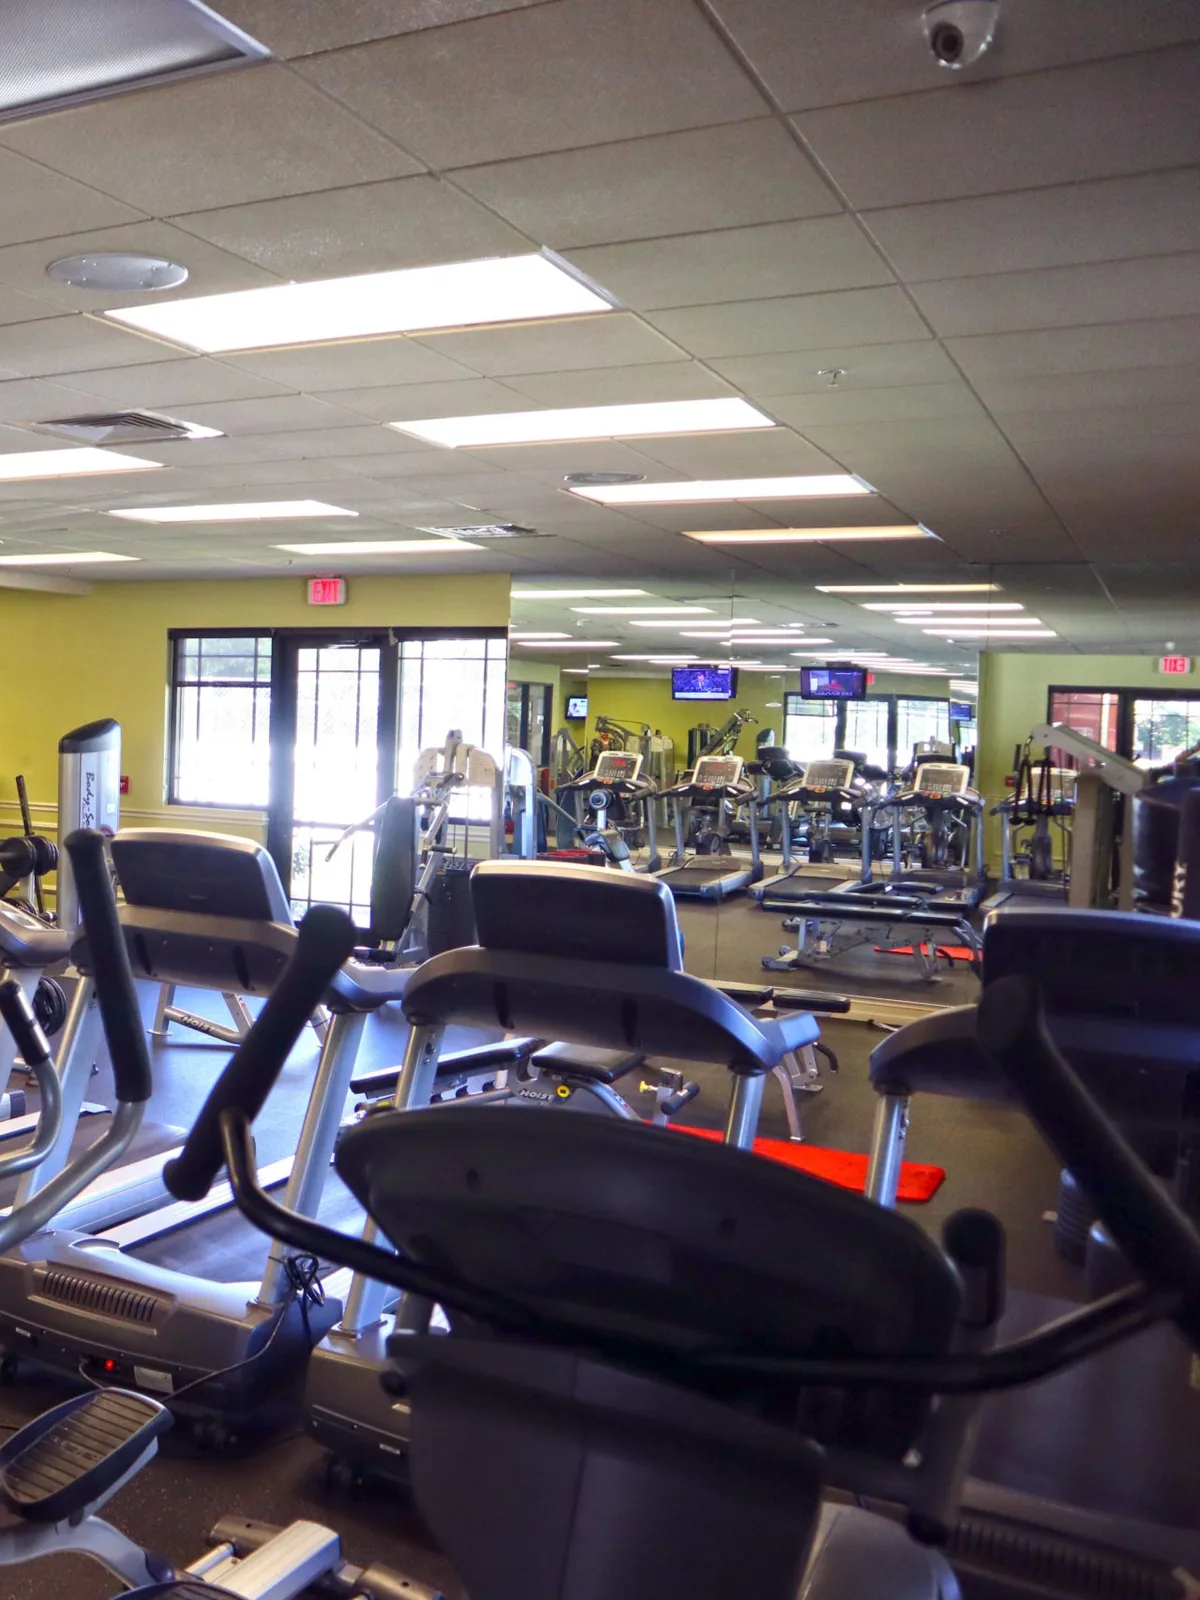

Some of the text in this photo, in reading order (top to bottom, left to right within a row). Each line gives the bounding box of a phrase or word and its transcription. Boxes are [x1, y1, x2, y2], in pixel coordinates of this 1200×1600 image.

[313, 580, 340, 603] EXIT
[82, 772, 95, 829] Body-So
[520, 1088, 554, 1101] HOIST
